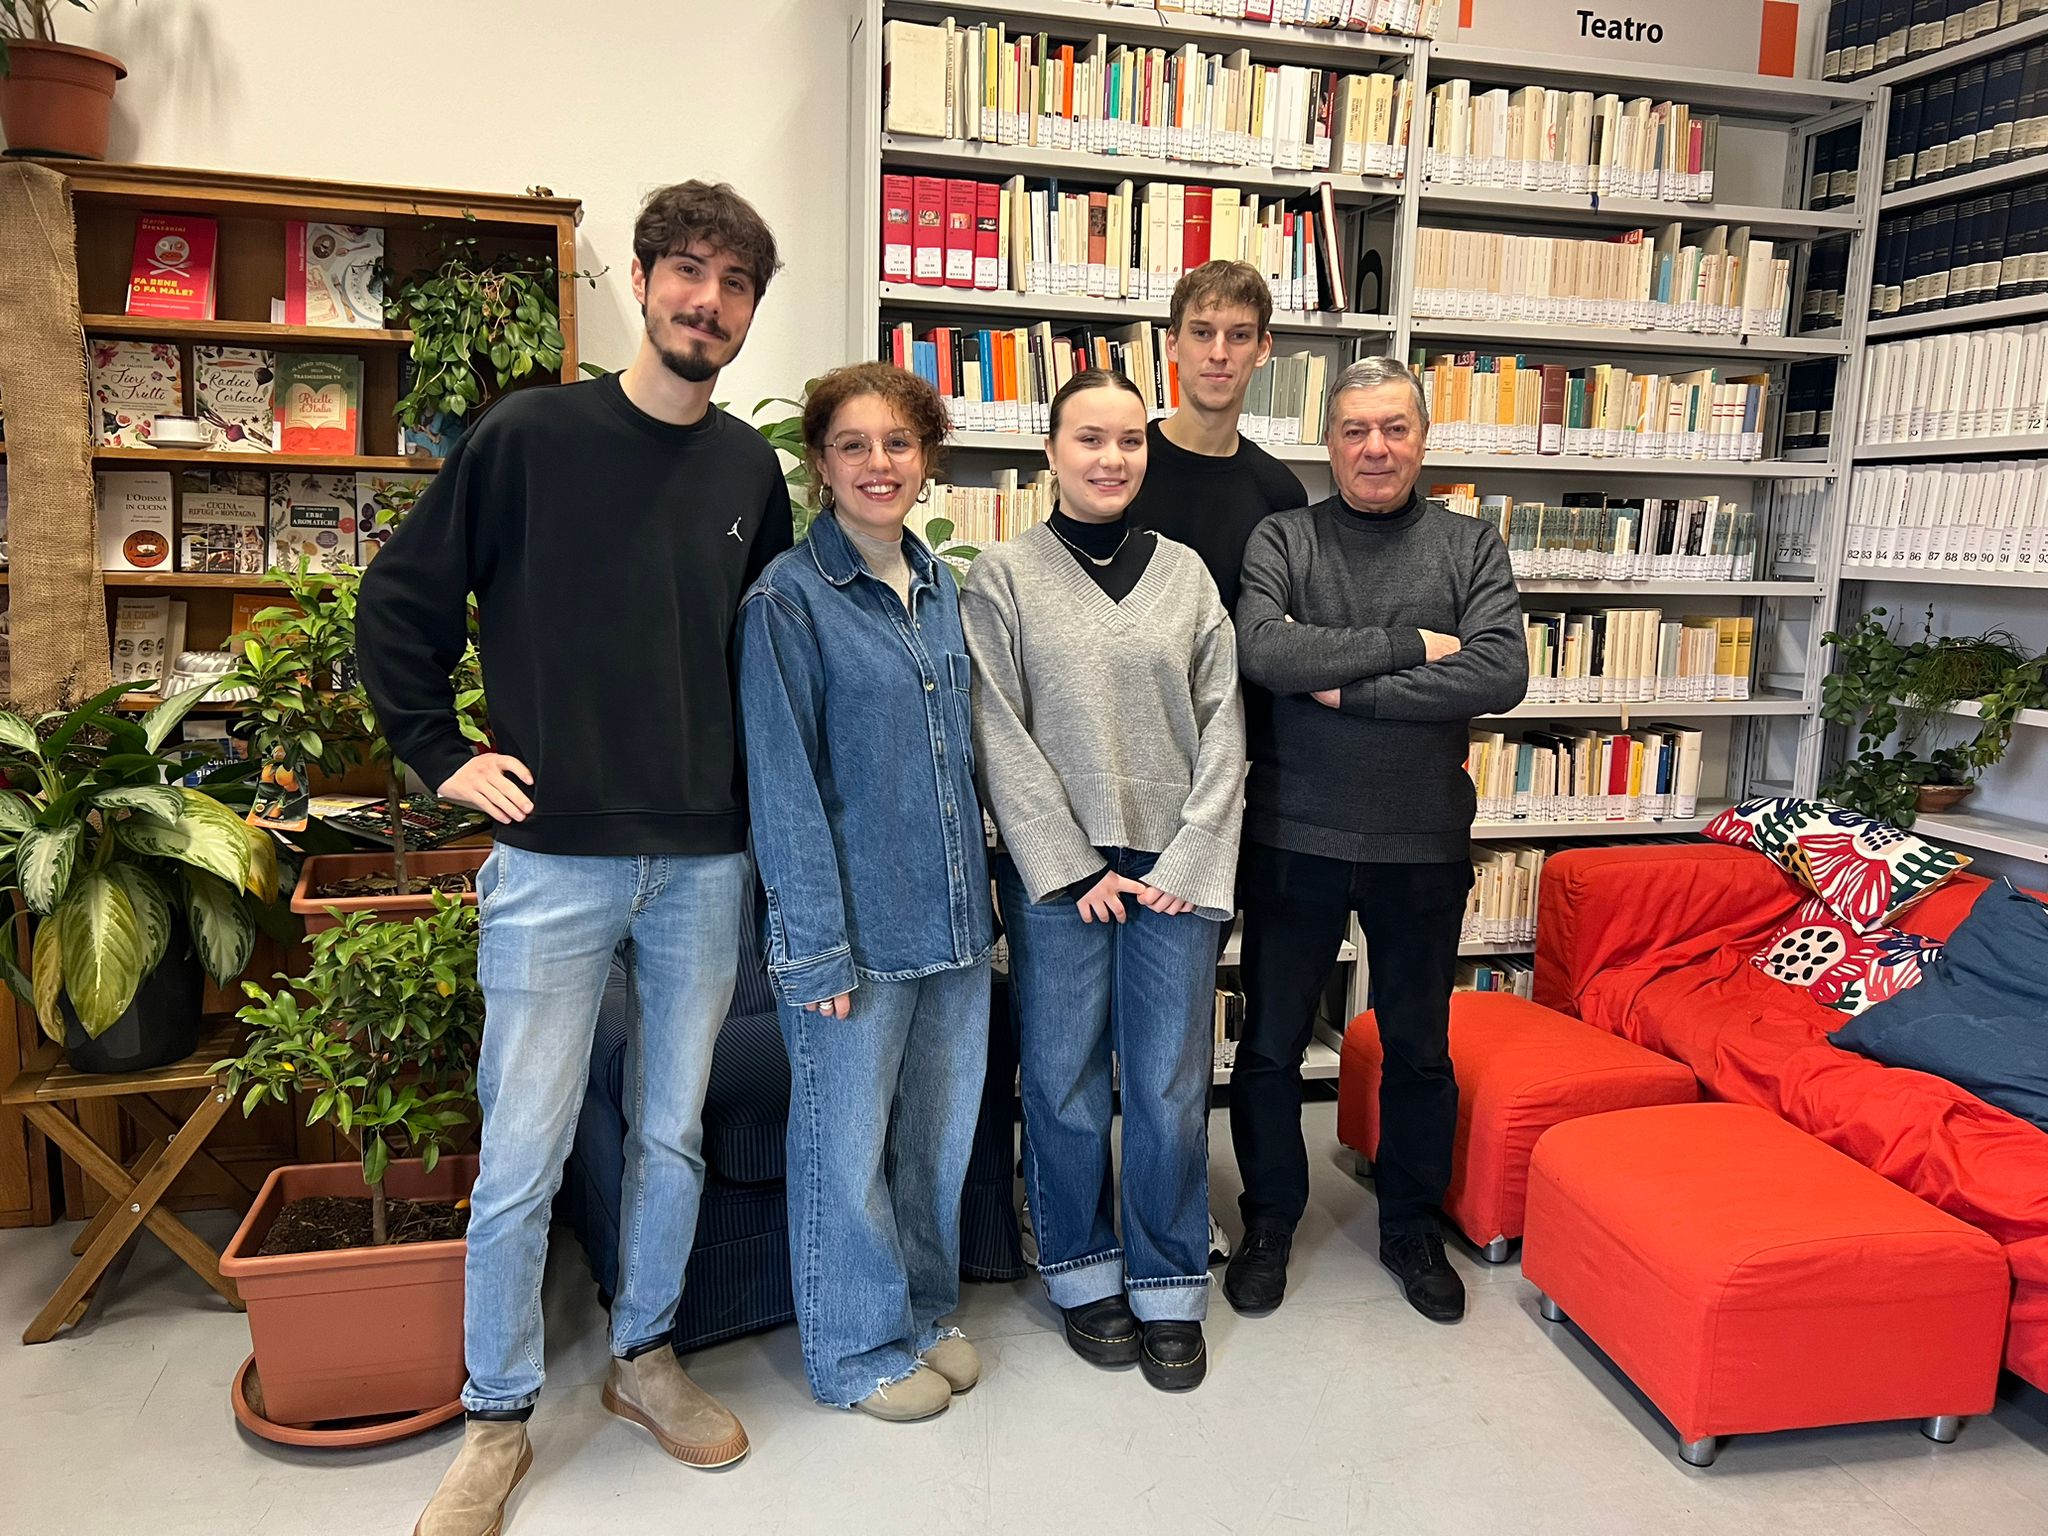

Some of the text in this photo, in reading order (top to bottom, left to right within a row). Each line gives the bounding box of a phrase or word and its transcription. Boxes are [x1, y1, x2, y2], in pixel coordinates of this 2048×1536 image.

[1577, 10, 1663, 43] Teatro
[150, 278, 178, 287] BENE
[160, 288, 194, 296] MALE?
[209, 371, 251, 390] Radici
[216, 388, 266, 404] Cortecce
[298, 392, 332, 404] Ricette
[206, 502, 237, 510] CUCINA
[188, 508, 214, 516] RIFUGI
[220, 510, 256, 518] MONTAGNA
[1779, 548, 1789, 556] 77
[1792, 548, 1802, 556] 78
[1848, 550, 1860, 559] 82
[1861, 550, 1872, 559] 83
[1876, 551, 1887, 559] 84
[1893, 551, 1904, 560] 85
[1910, 552, 1922, 561] 86
[1928, 552, 1940, 560] 87
[1944, 552, 1958, 562] 88
[1963, 552, 1977, 562] 89
[1981, 553, 1994, 563] 90
[2000, 554, 2010, 564] 91
[2019, 554, 2031, 564] 92
[2038, 554, 2048, 564] 93
[208, 758, 239, 766] Cucina
